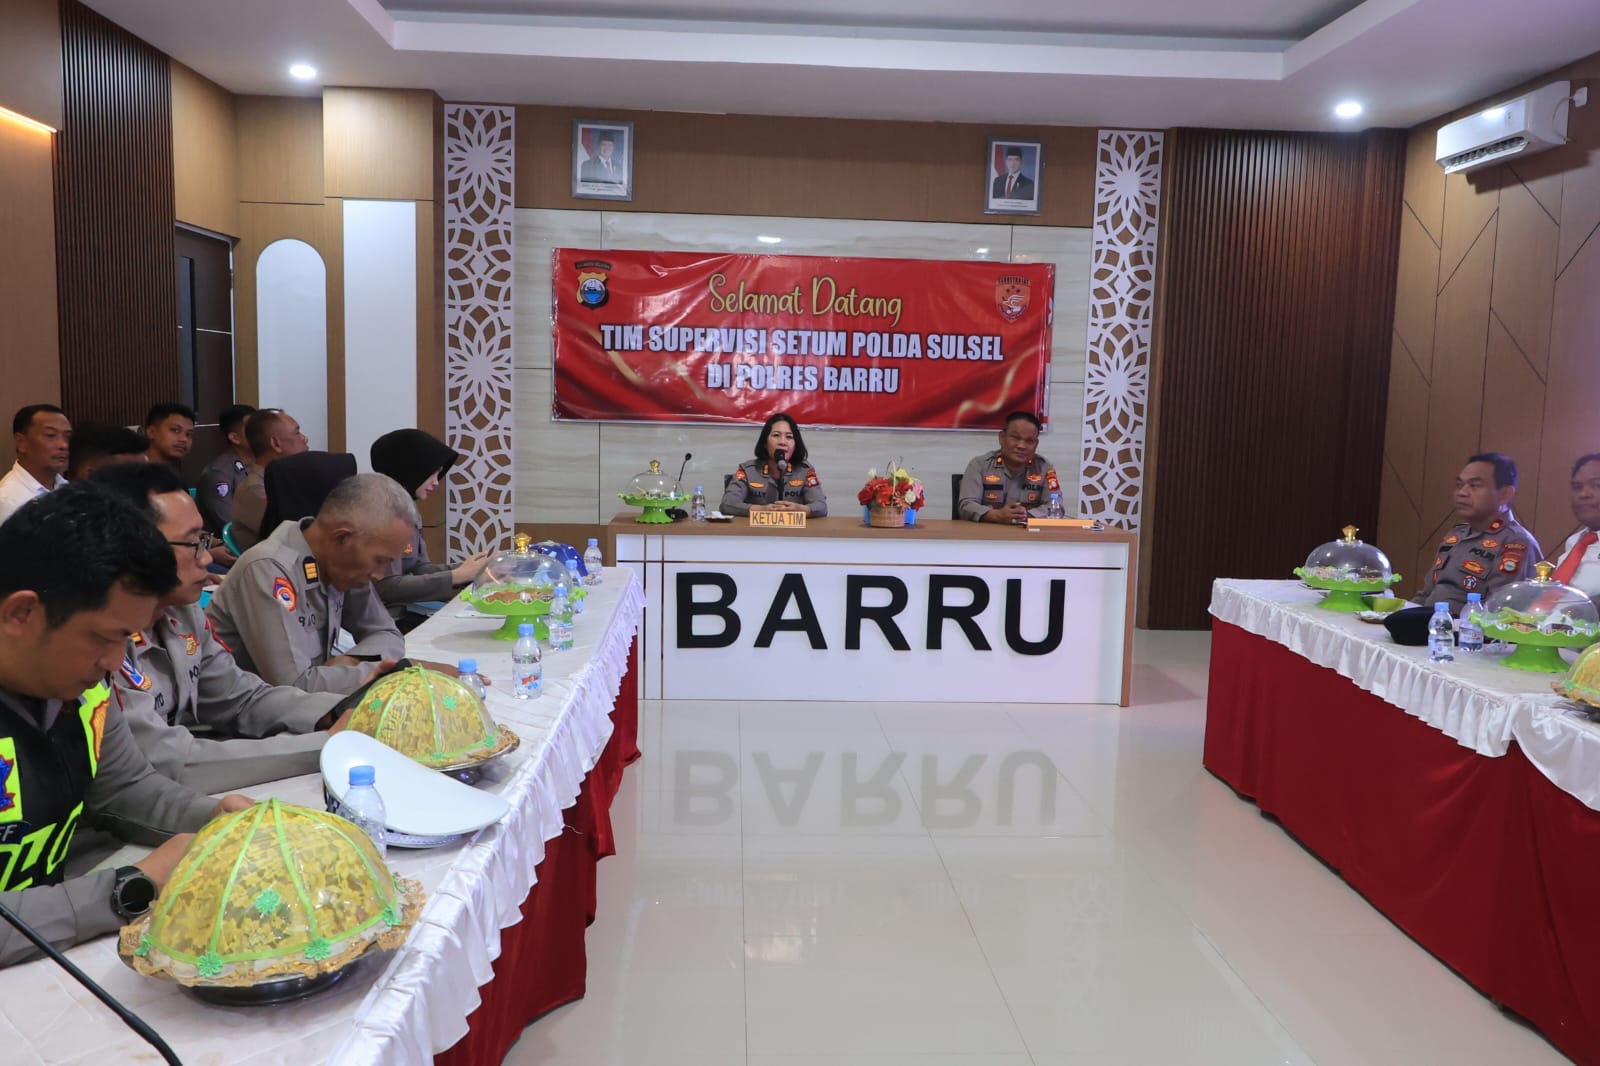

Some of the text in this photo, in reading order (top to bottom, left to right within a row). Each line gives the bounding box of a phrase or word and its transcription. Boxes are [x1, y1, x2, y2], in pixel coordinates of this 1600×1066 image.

[708, 273, 902, 328] Selamat Datang
[600, 325, 1004, 361] TIM SUPERVISI SETUM POLDA SULSEL
[707, 363, 899, 393] DI POLRES BARRU
[752, 512, 804, 526] KETUA TIM
[676, 572, 1066, 656] BARRU
